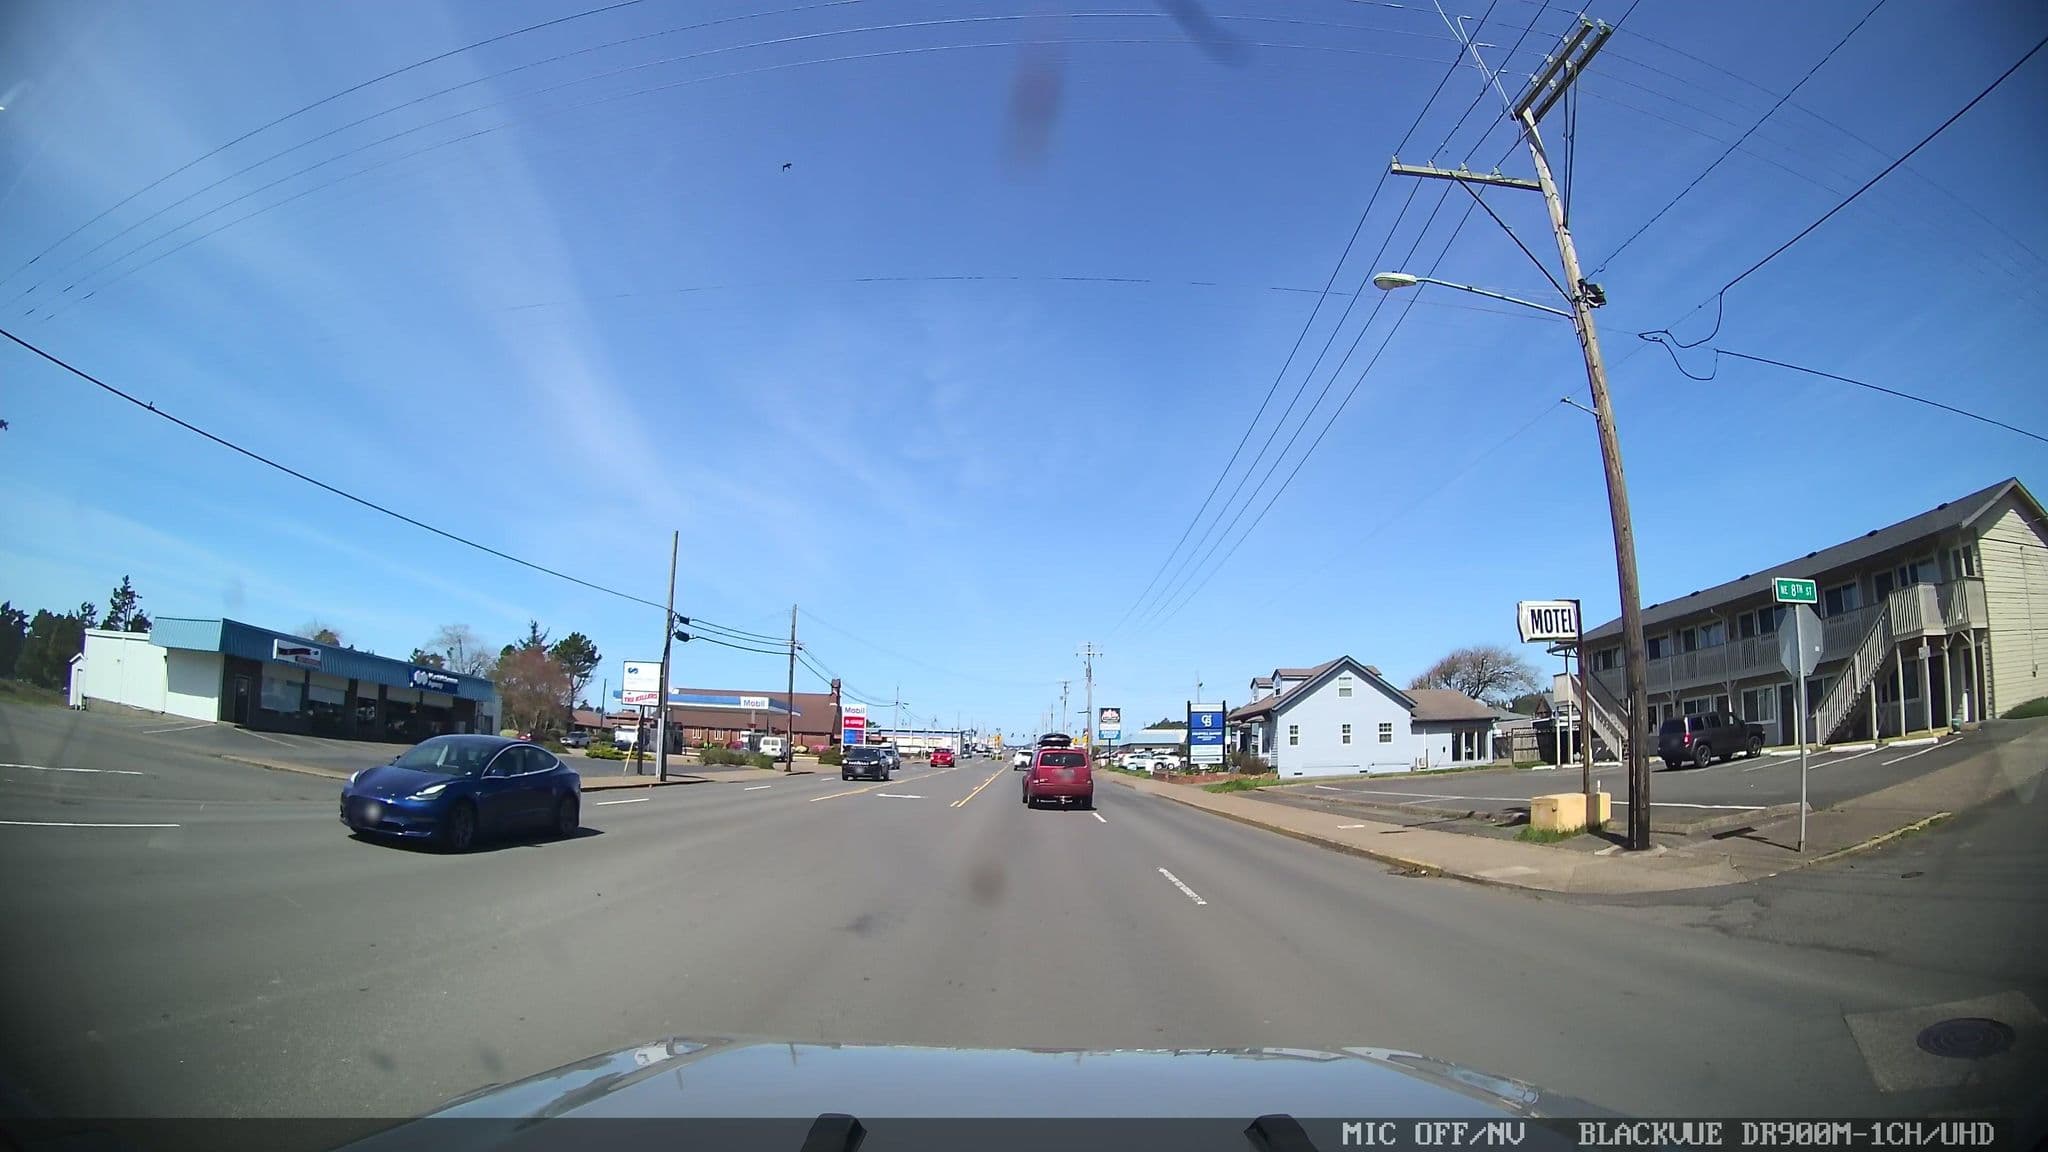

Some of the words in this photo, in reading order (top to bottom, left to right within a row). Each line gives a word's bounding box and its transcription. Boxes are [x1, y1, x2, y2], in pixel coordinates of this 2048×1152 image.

[1781, 584, 1788, 595] NE
[1791, 583, 1803, 597] 8TH
[1805, 586, 1812, 597] ST
[1530, 608, 1575, 635] MOTEL
[743, 699, 766, 708] Mobil
[844, 706, 865, 714] Mobil
